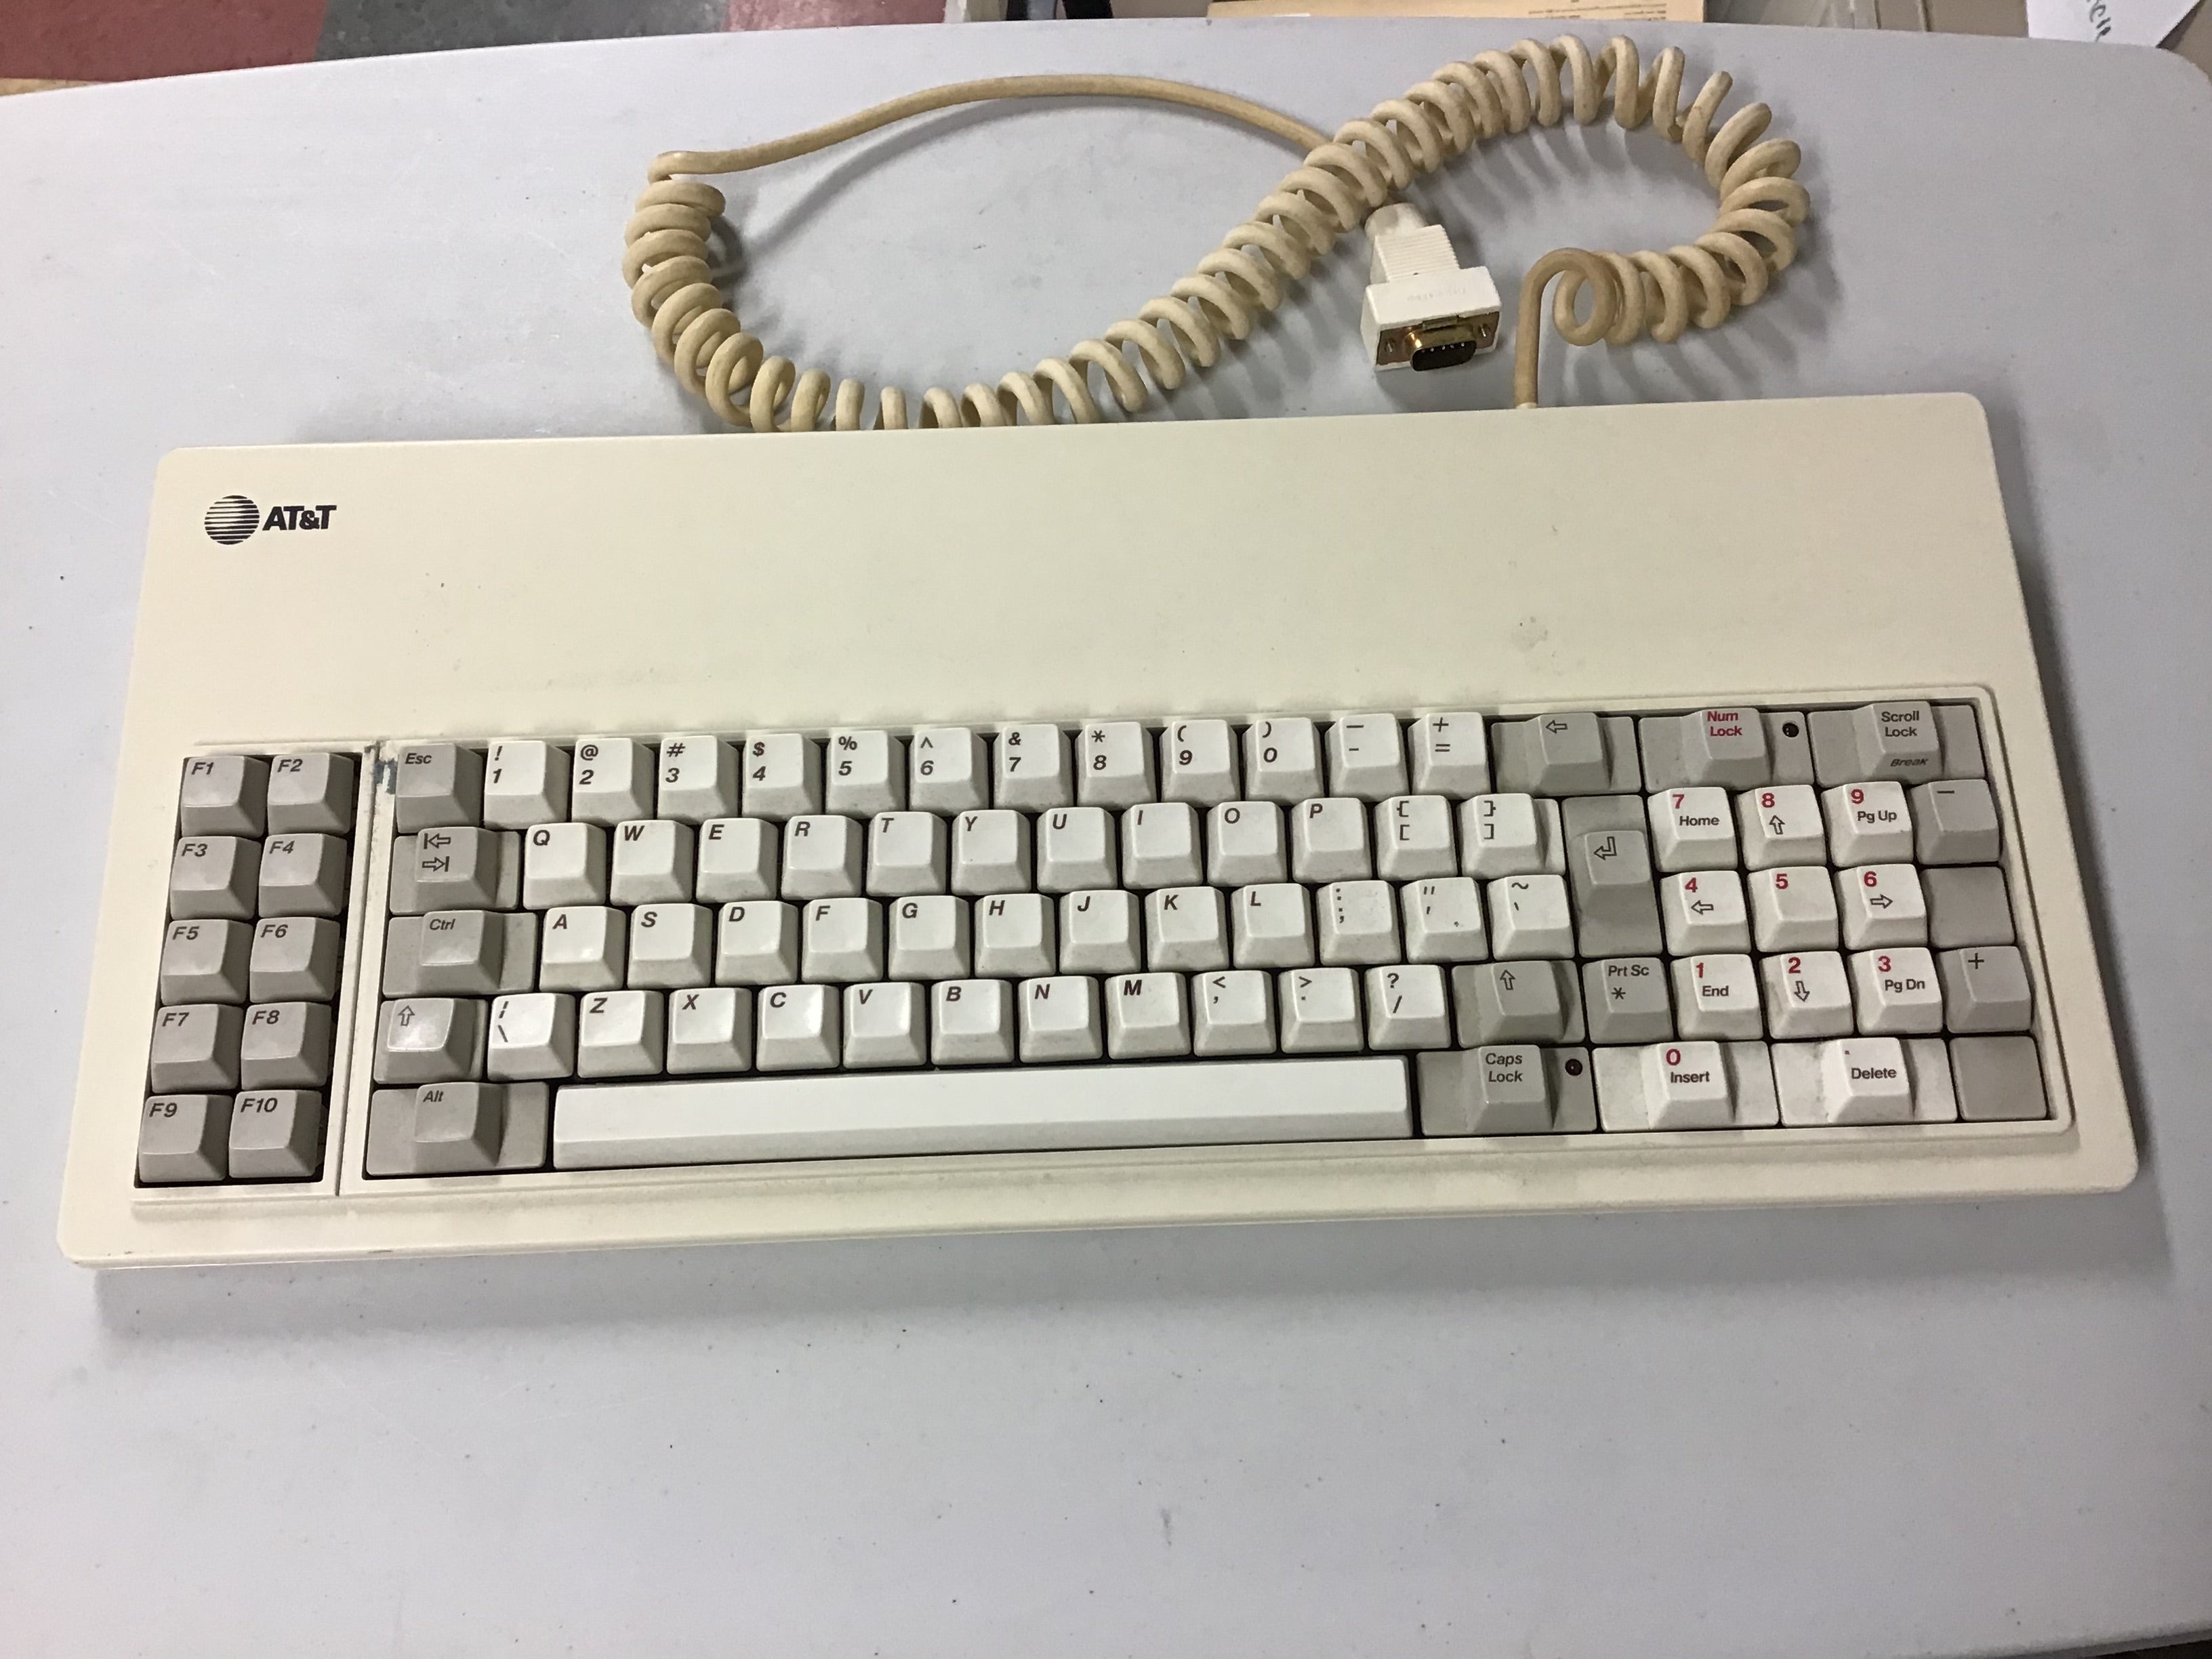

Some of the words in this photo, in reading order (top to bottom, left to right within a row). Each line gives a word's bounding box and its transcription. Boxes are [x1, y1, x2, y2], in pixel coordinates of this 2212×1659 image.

[262, 505, 337, 531] AT&T
[1707, 710, 1738, 722] Num
[1881, 710, 1919, 722] Scroll
[1710, 726, 1742, 737] Lock
[1885, 726, 1918, 738] Lock
[405, 752, 432, 764] Esc
[1179, 750, 1193, 766] 9
[1263, 747, 1277, 763] 0
[1890, 757, 1929, 768] Break
[191, 762, 214, 775] F1
[277, 759, 303, 773] F2
[838, 761, 853, 776] 5
[920, 760, 934, 776] 6
[1008, 756, 1021, 772] 7
[1093, 755, 1107, 771] 8
[493, 769, 501, 783] 1
[579, 769, 594, 785] 2
[665, 768, 680, 783] 3
[752, 766, 766, 781] 4
[1672, 794, 1685, 809] 7
[1762, 793, 1775, 808] 8
[1851, 789, 1864, 804] 9
[1137, 810, 1144, 825] I
[1225, 808, 1240, 824] O
[1309, 804, 1323, 819] P
[1857, 811, 1875, 824] Pg
[1879, 811, 1897, 823] Up
[881, 817, 895, 833] T
[965, 816, 978, 832] Y
[1052, 814, 1067, 830] U
[1679, 815, 1720, 826] Home
[624, 825, 644, 841] W
[708, 824, 724, 840] E
[794, 821, 811, 837] R
[533, 830, 550, 846] Q
[182, 844, 208, 857] F3
[269, 840, 295, 854] F4
[1684, 878, 1698, 893] 4
[1775, 873, 1789, 889] 5
[1863, 872, 1878, 887] 6
[1077, 896, 1091, 912] J
[1164, 894, 1179, 910] K
[1250, 891, 1261, 907] L
[729, 907, 745, 923] D
[815, 905, 831, 922] F
[902, 903, 919, 918] G
[989, 900, 1006, 916] H
[429, 918, 456, 931] Ctrl
[552, 914, 569, 930] A
[641, 912, 657, 928] S
[172, 926, 200, 940] F5
[260, 924, 289, 938] F6
[1608, 964, 1628, 977] Prt
[1631, 964, 1650, 977] Sc
[1695, 962, 1704, 978] 1
[1788, 957, 1801, 974] 2
[1878, 956, 1891, 972] 3
[1034, 983, 1051, 1000] N
[1123, 979, 1143, 996] M
[1702, 985, 1729, 997] End
[1885, 979, 1902, 993] Pg
[1906, 979, 1925, 991] Dn
[770, 992, 786, 1008] C
[859, 989, 874, 1004] V
[945, 986, 962, 1002] B
[590, 998, 608, 1014] Z
[682, 994, 700, 1010] X
[162, 1012, 190, 1027] F7
[251, 1010, 280, 1025] F8
[1486, 1052, 1523, 1067] Caps
[1666, 1048, 1681, 1066] 0
[1488, 1071, 1523, 1083] Lock
[1671, 1071, 1711, 1084] Insert
[1851, 1067, 1897, 1080] Delete
[423, 1089, 444, 1103] Alt
[149, 1103, 178, 1118] F9
[240, 1098, 278, 1113] F10
